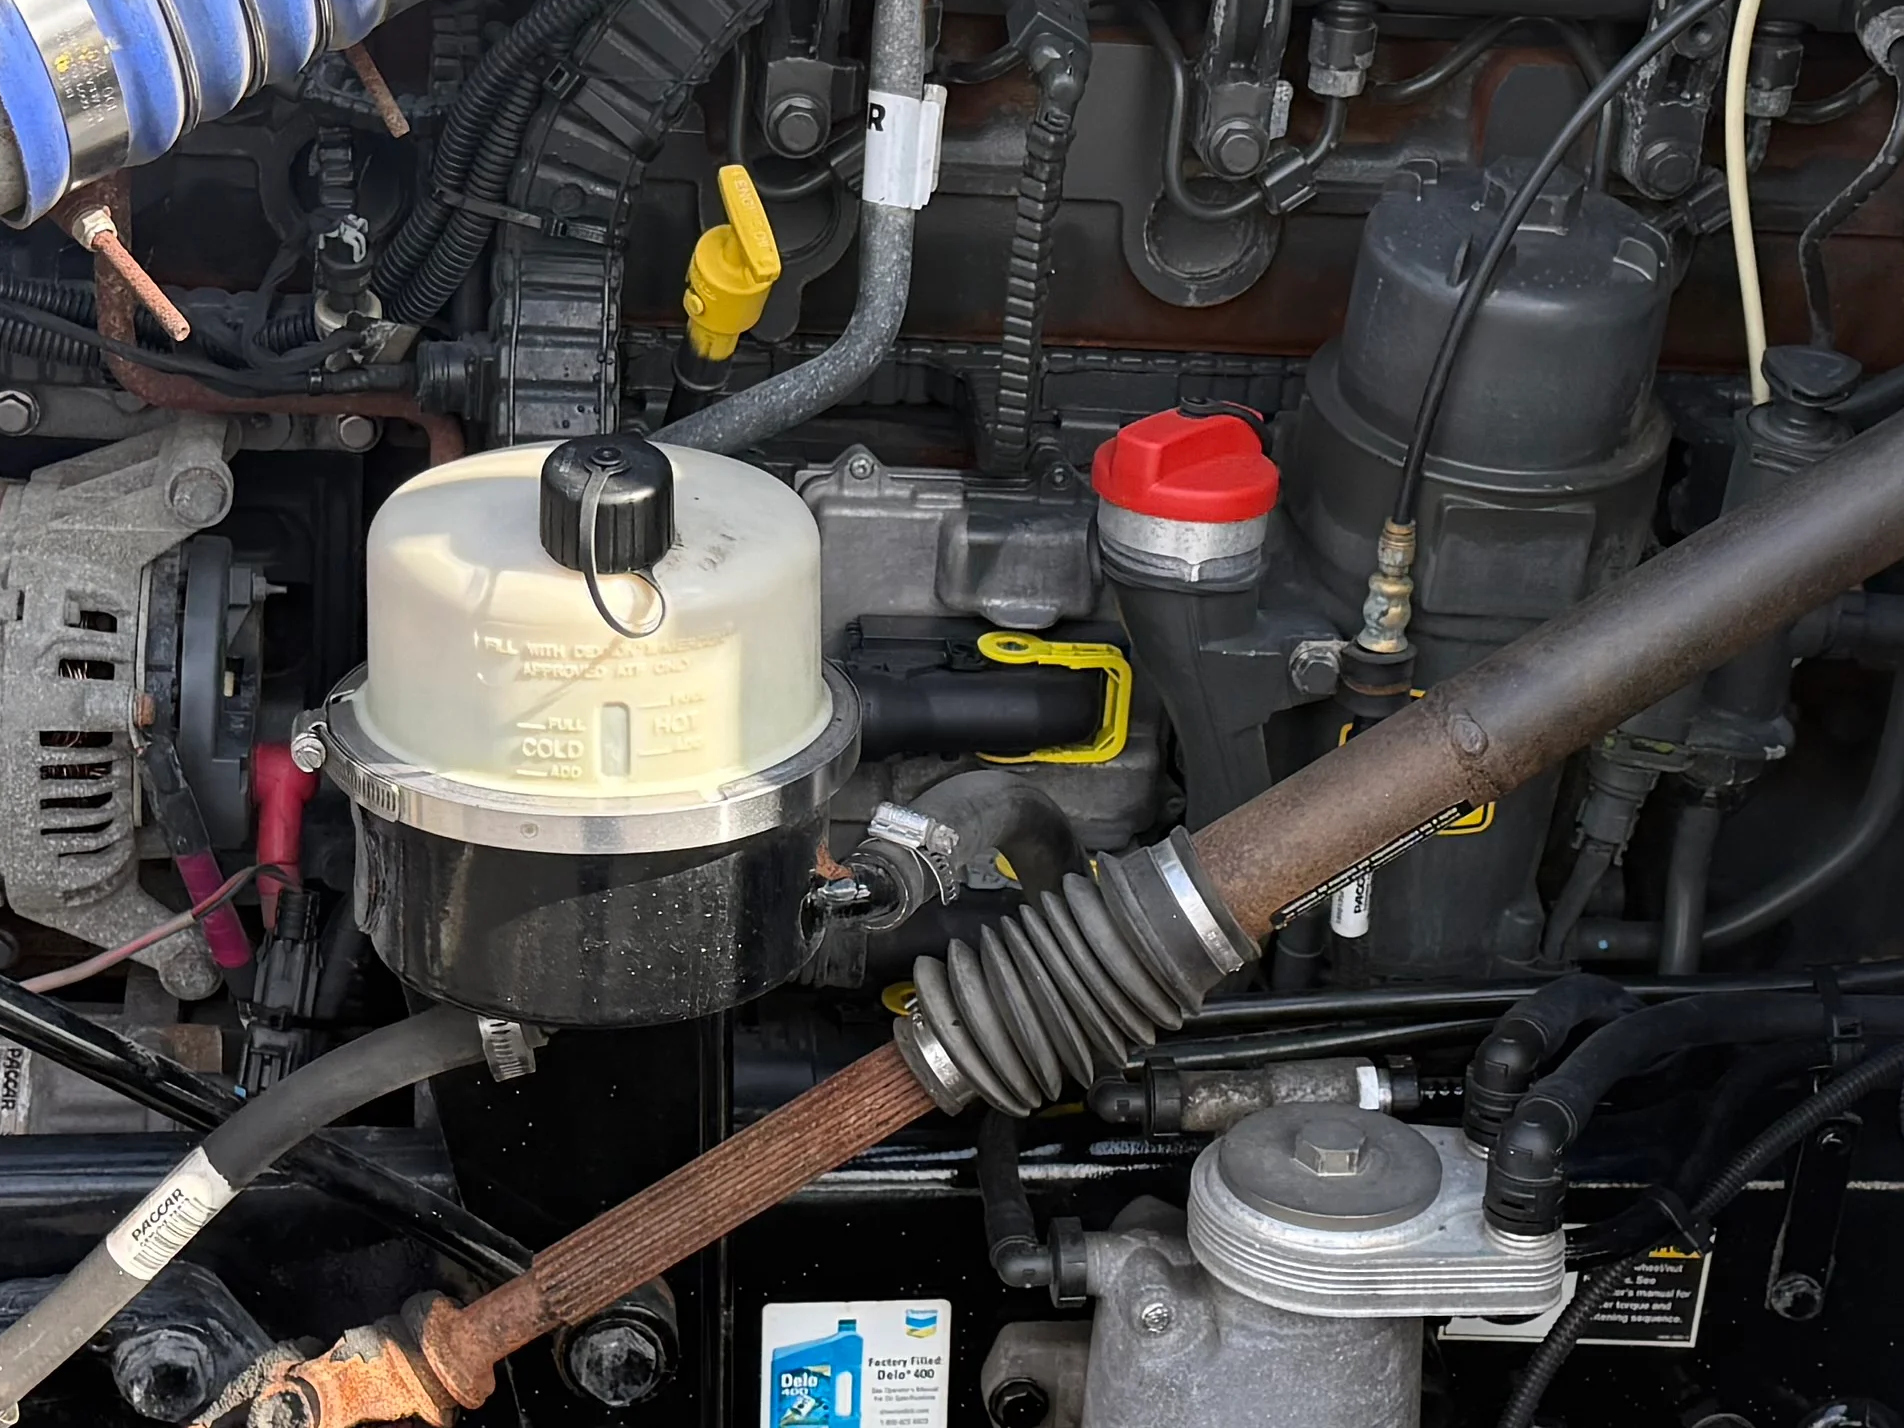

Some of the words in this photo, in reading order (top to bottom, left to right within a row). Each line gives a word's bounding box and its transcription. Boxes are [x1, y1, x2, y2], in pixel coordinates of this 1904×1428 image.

[527, 642, 565, 658] WITH
[548, 717, 587, 732] FULL
[522, 738, 585, 759] COLD
[653, 715, 698, 735] HOT
[550, 765, 582, 778] ADD
[1, 1048, 24, 1110] PACCAR
[131, 1188, 184, 1241] PACCAR
[1636, 1276, 1656, 1285] See
[1636, 1289, 1674, 1298] manual
[1676, 1290, 1691, 1298] for
[1616, 1301, 1649, 1310] torque
[1652, 1302, 1672, 1310] and
[1631, 1315, 1683, 1324] sequence.
[868, 1357, 908, 1367] Factory
[781, 1373, 818, 1388] Delo
[914, 1370, 934, 1379] 400
